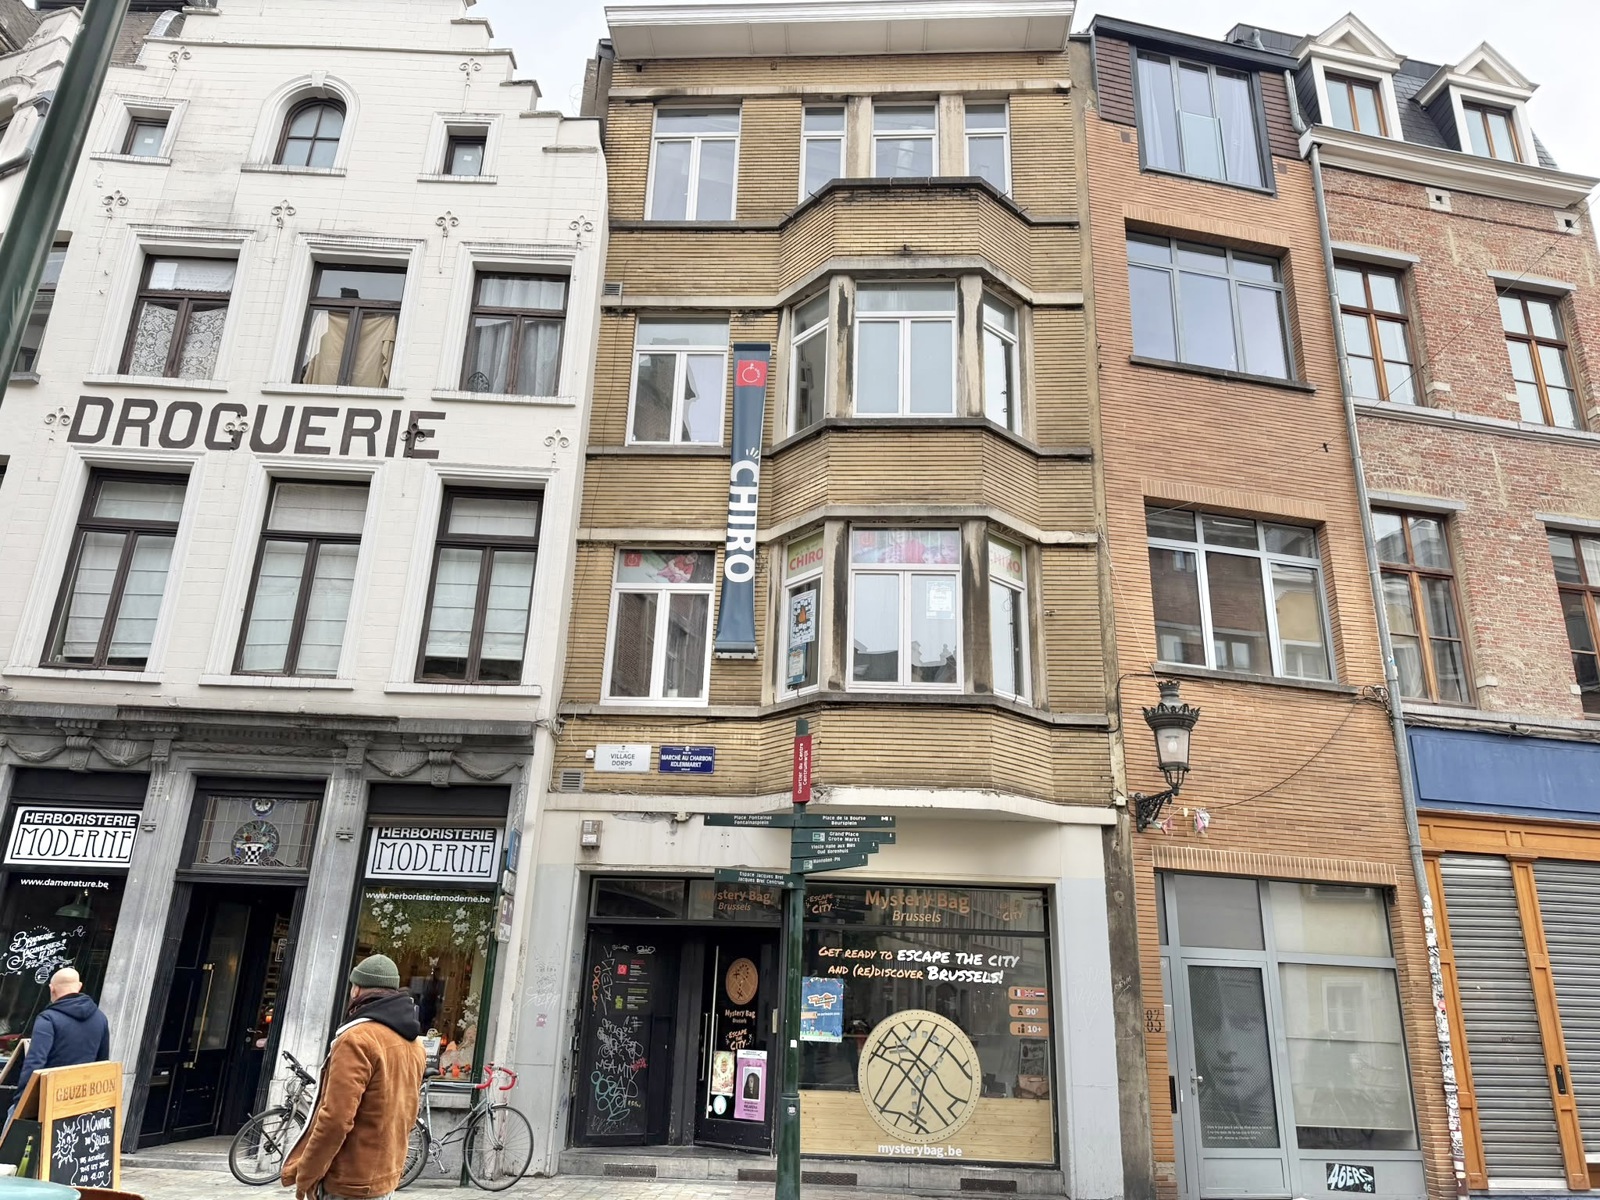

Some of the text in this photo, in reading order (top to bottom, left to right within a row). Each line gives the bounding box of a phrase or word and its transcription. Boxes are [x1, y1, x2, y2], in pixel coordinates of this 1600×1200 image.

[67, 395, 447, 458] DROGUERIE
[724, 459, 758, 583] CHIRO
[789, 547, 824, 570] CHIRO
[990, 553, 1022, 574] HIRO
[661, 753, 681, 761] MARCHÉ
[23, 812, 137, 827] HERBORISTERIE
[381, 827, 494, 841] HERBORISTERIE
[15, 828, 132, 859] MODERNE
[376, 842, 491, 874] MODERNE
[20, 878, 109, 889] www.damenature.be
[366, 892, 491, 904] www.herboristeriemoderne.be
[700, 890, 771, 905] Mystery Bag
[809, 893, 834, 903] ESCAPE
[865, 890, 970, 914] Mystery Bag
[718, 902, 752, 911] Brussels
[811, 904, 833, 914] CITY
[893, 910, 942, 923] Brussels
[818, 946, 1020, 968] GET READY TO ESCAPE THE CITY
[828, 964, 1004, 984] AND (RE)DISCOVER BRUSSELS!
[725, 1009, 756, 1019] Mystery Bag
[728, 1028, 748, 1039] ESCAPE
[1027, 1025, 1042, 1033] 10+
[730, 1040, 747, 1051] CITY
[55, 1079, 116, 1102] GEUZE BOON
[81, 1118, 90, 1134] LA
[877, 1144, 962, 1158] mysterybag.be
[1327, 1163, 1374, 1192] 46ERS 46
